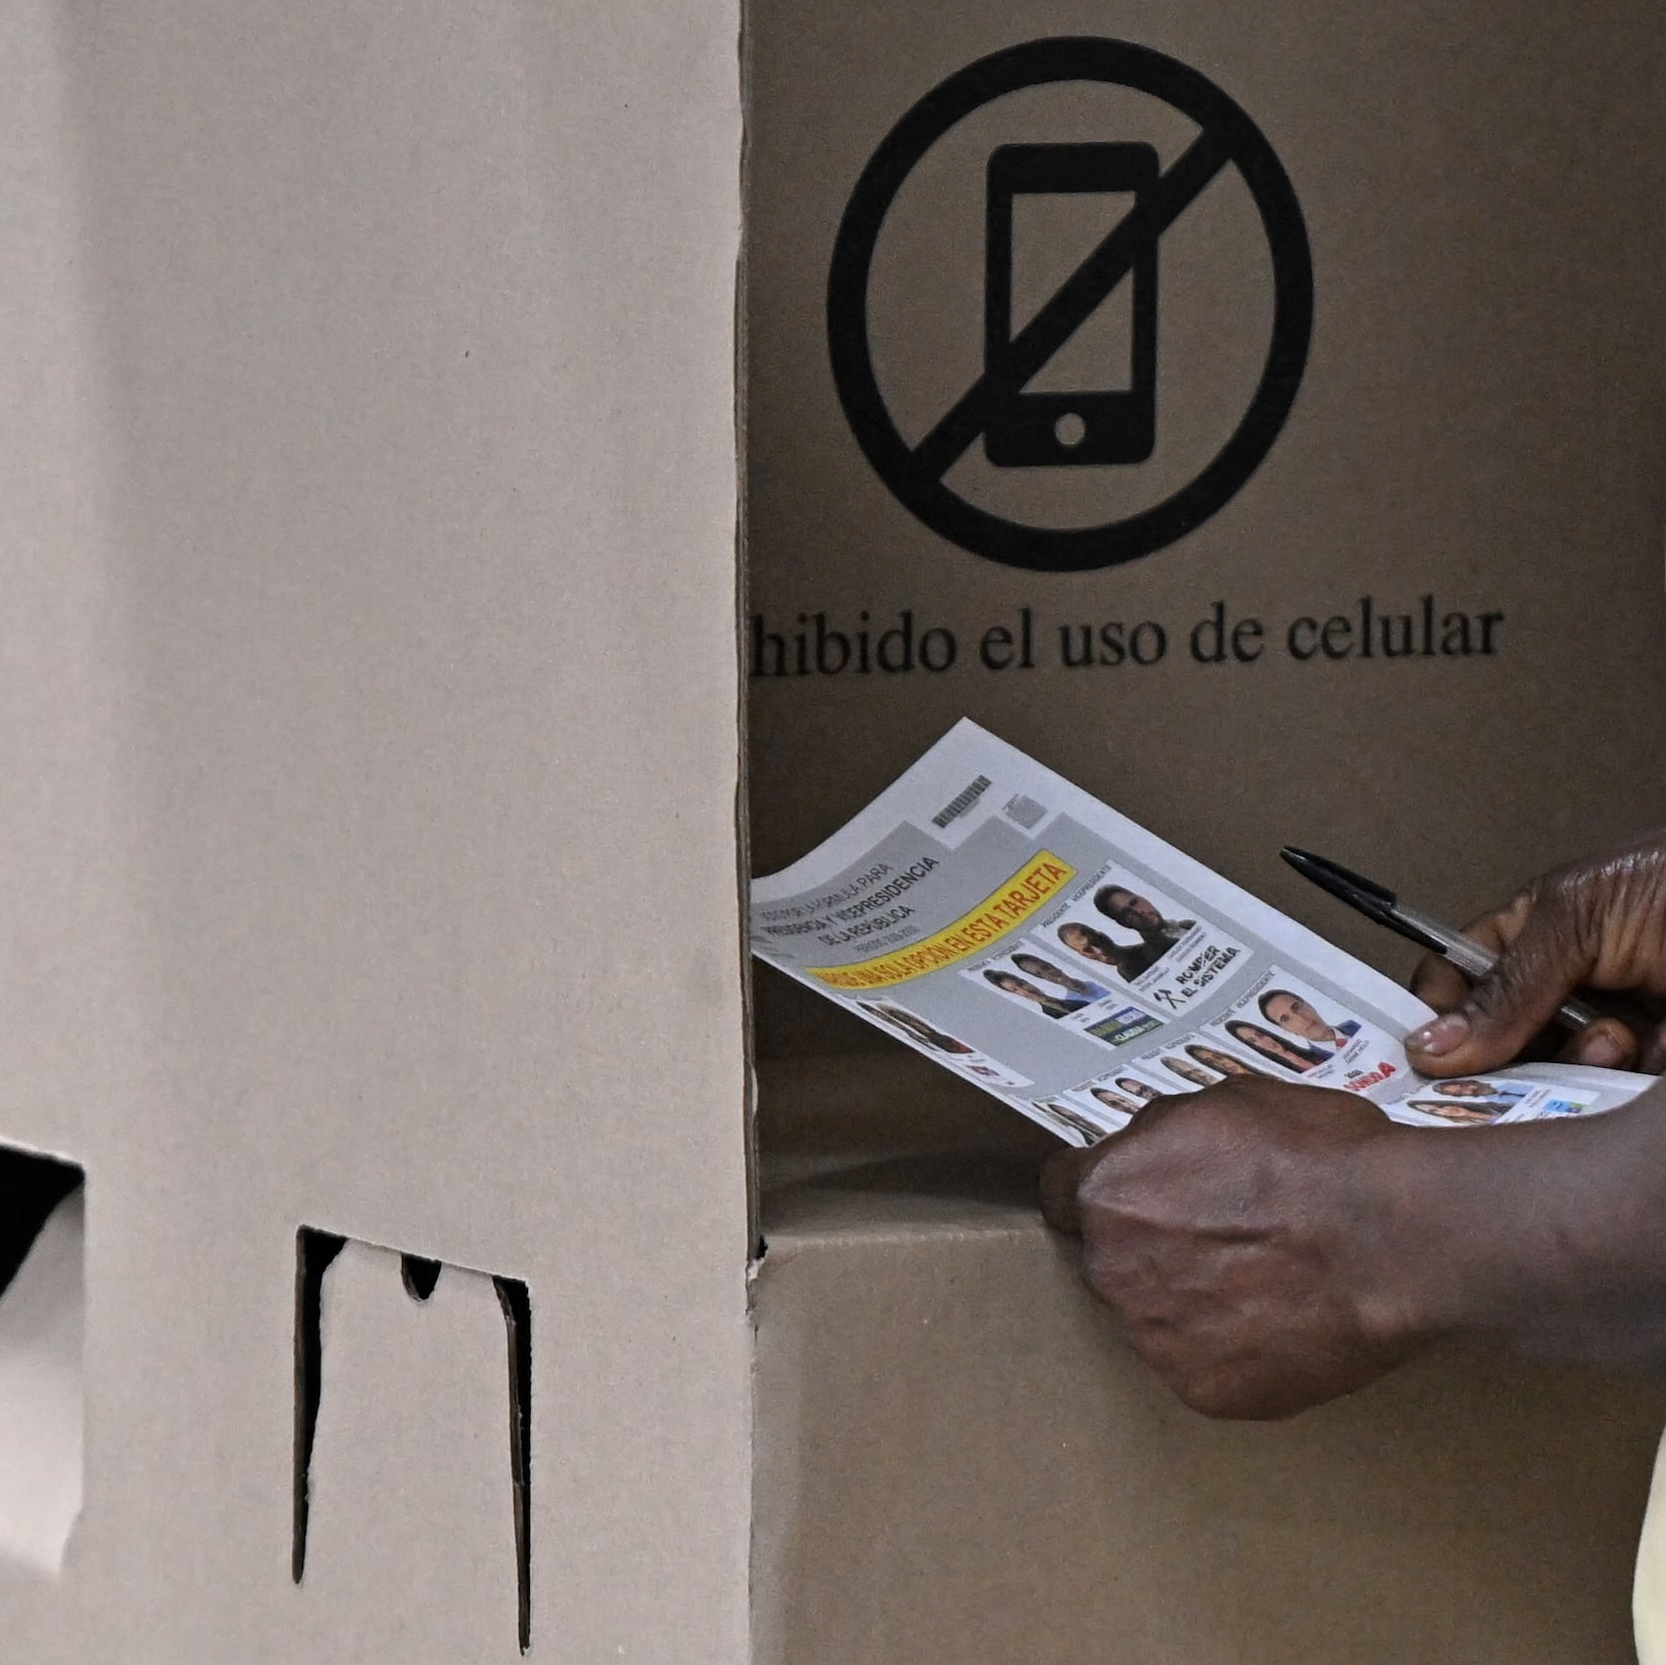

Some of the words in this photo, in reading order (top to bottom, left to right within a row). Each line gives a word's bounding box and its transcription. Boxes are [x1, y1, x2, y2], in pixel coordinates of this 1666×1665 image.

[978, 606, 1036, 674] el
[1057, 619, 1169, 671] uso
[1189, 600, 1265, 666] de
[1286, 593, 1509, 663] celular
[856, 862, 894, 888] PARA
[943, 933, 976, 953] EN
[960, 911, 1011, 943] ESTA
[992, 861, 1069, 919] TARJETA
[1174, 944, 1221, 985] ROMPER
[1180, 986, 1200, 998] EL
[1192, 946, 1242, 988] SISTEMA
